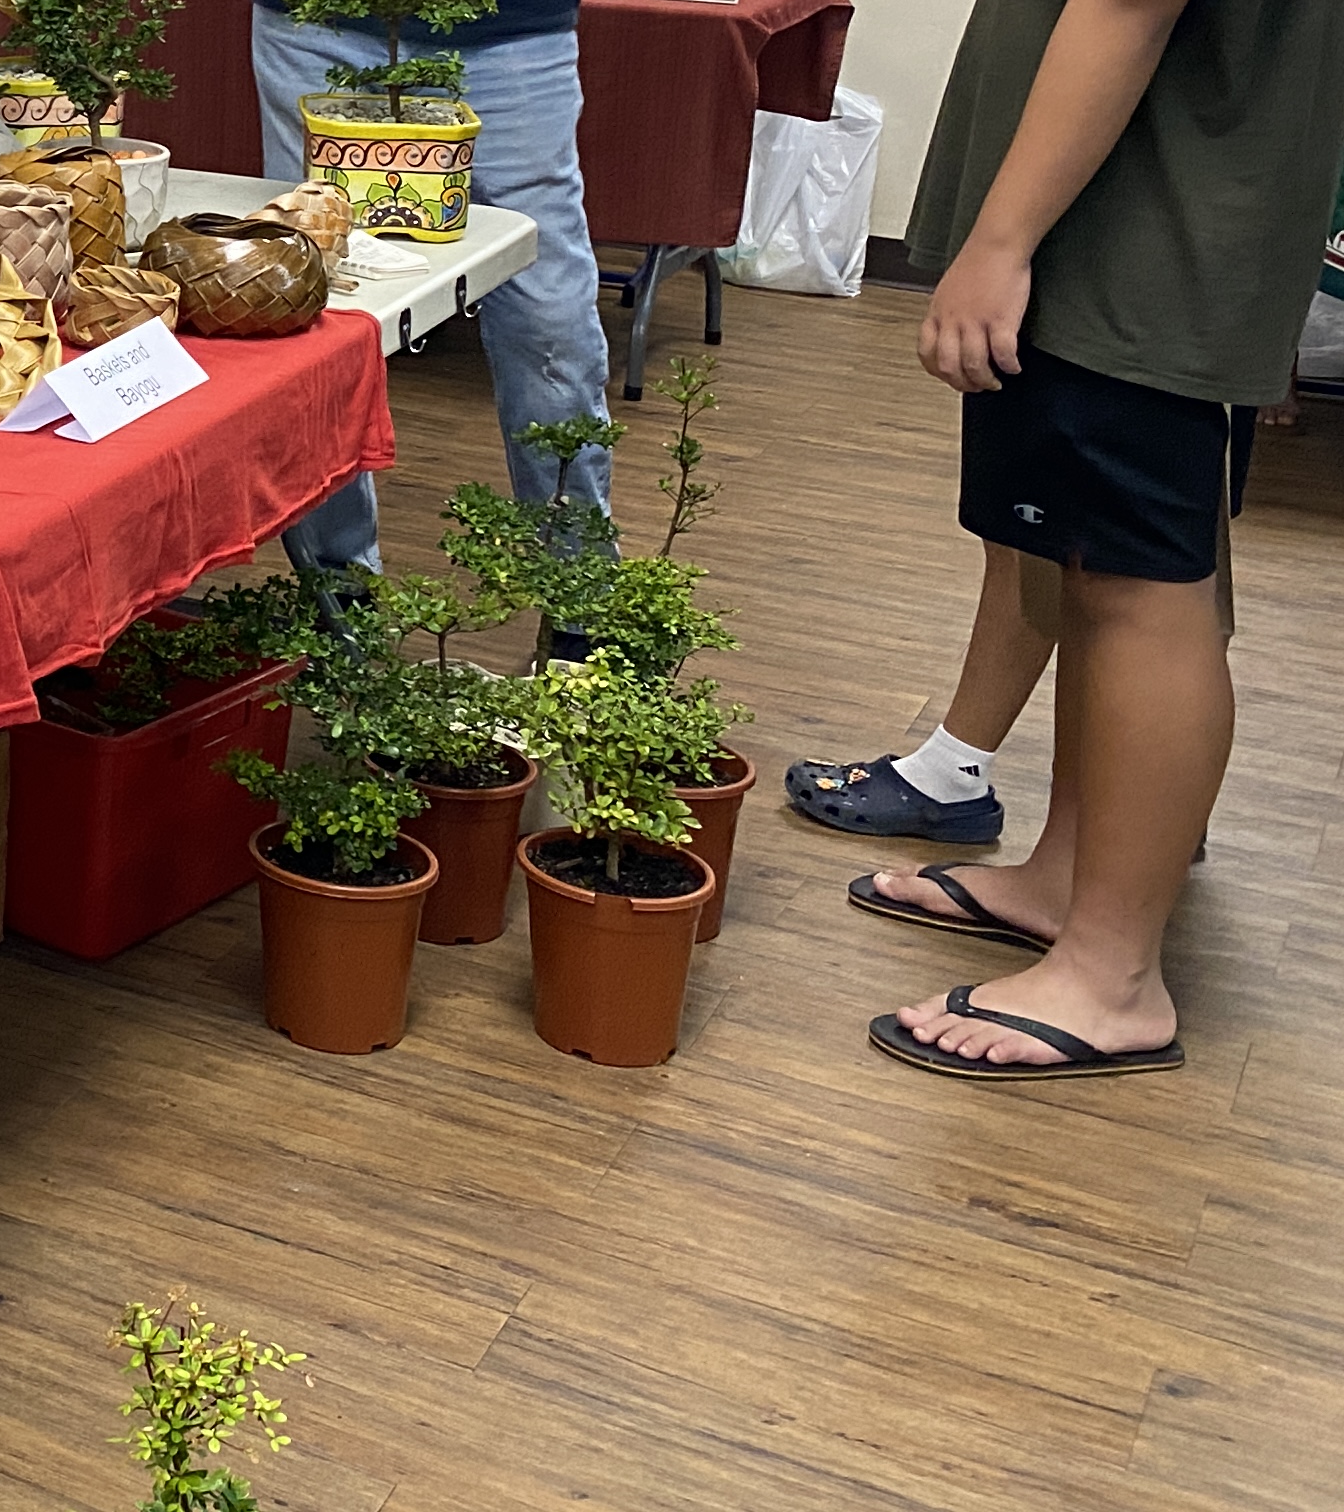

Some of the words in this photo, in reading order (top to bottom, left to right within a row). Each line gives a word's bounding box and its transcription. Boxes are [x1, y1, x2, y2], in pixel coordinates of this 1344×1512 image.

[83, 354, 131, 386] Baskets
[127, 340, 150, 365] and
[115, 375, 161, 407] Bayogu
